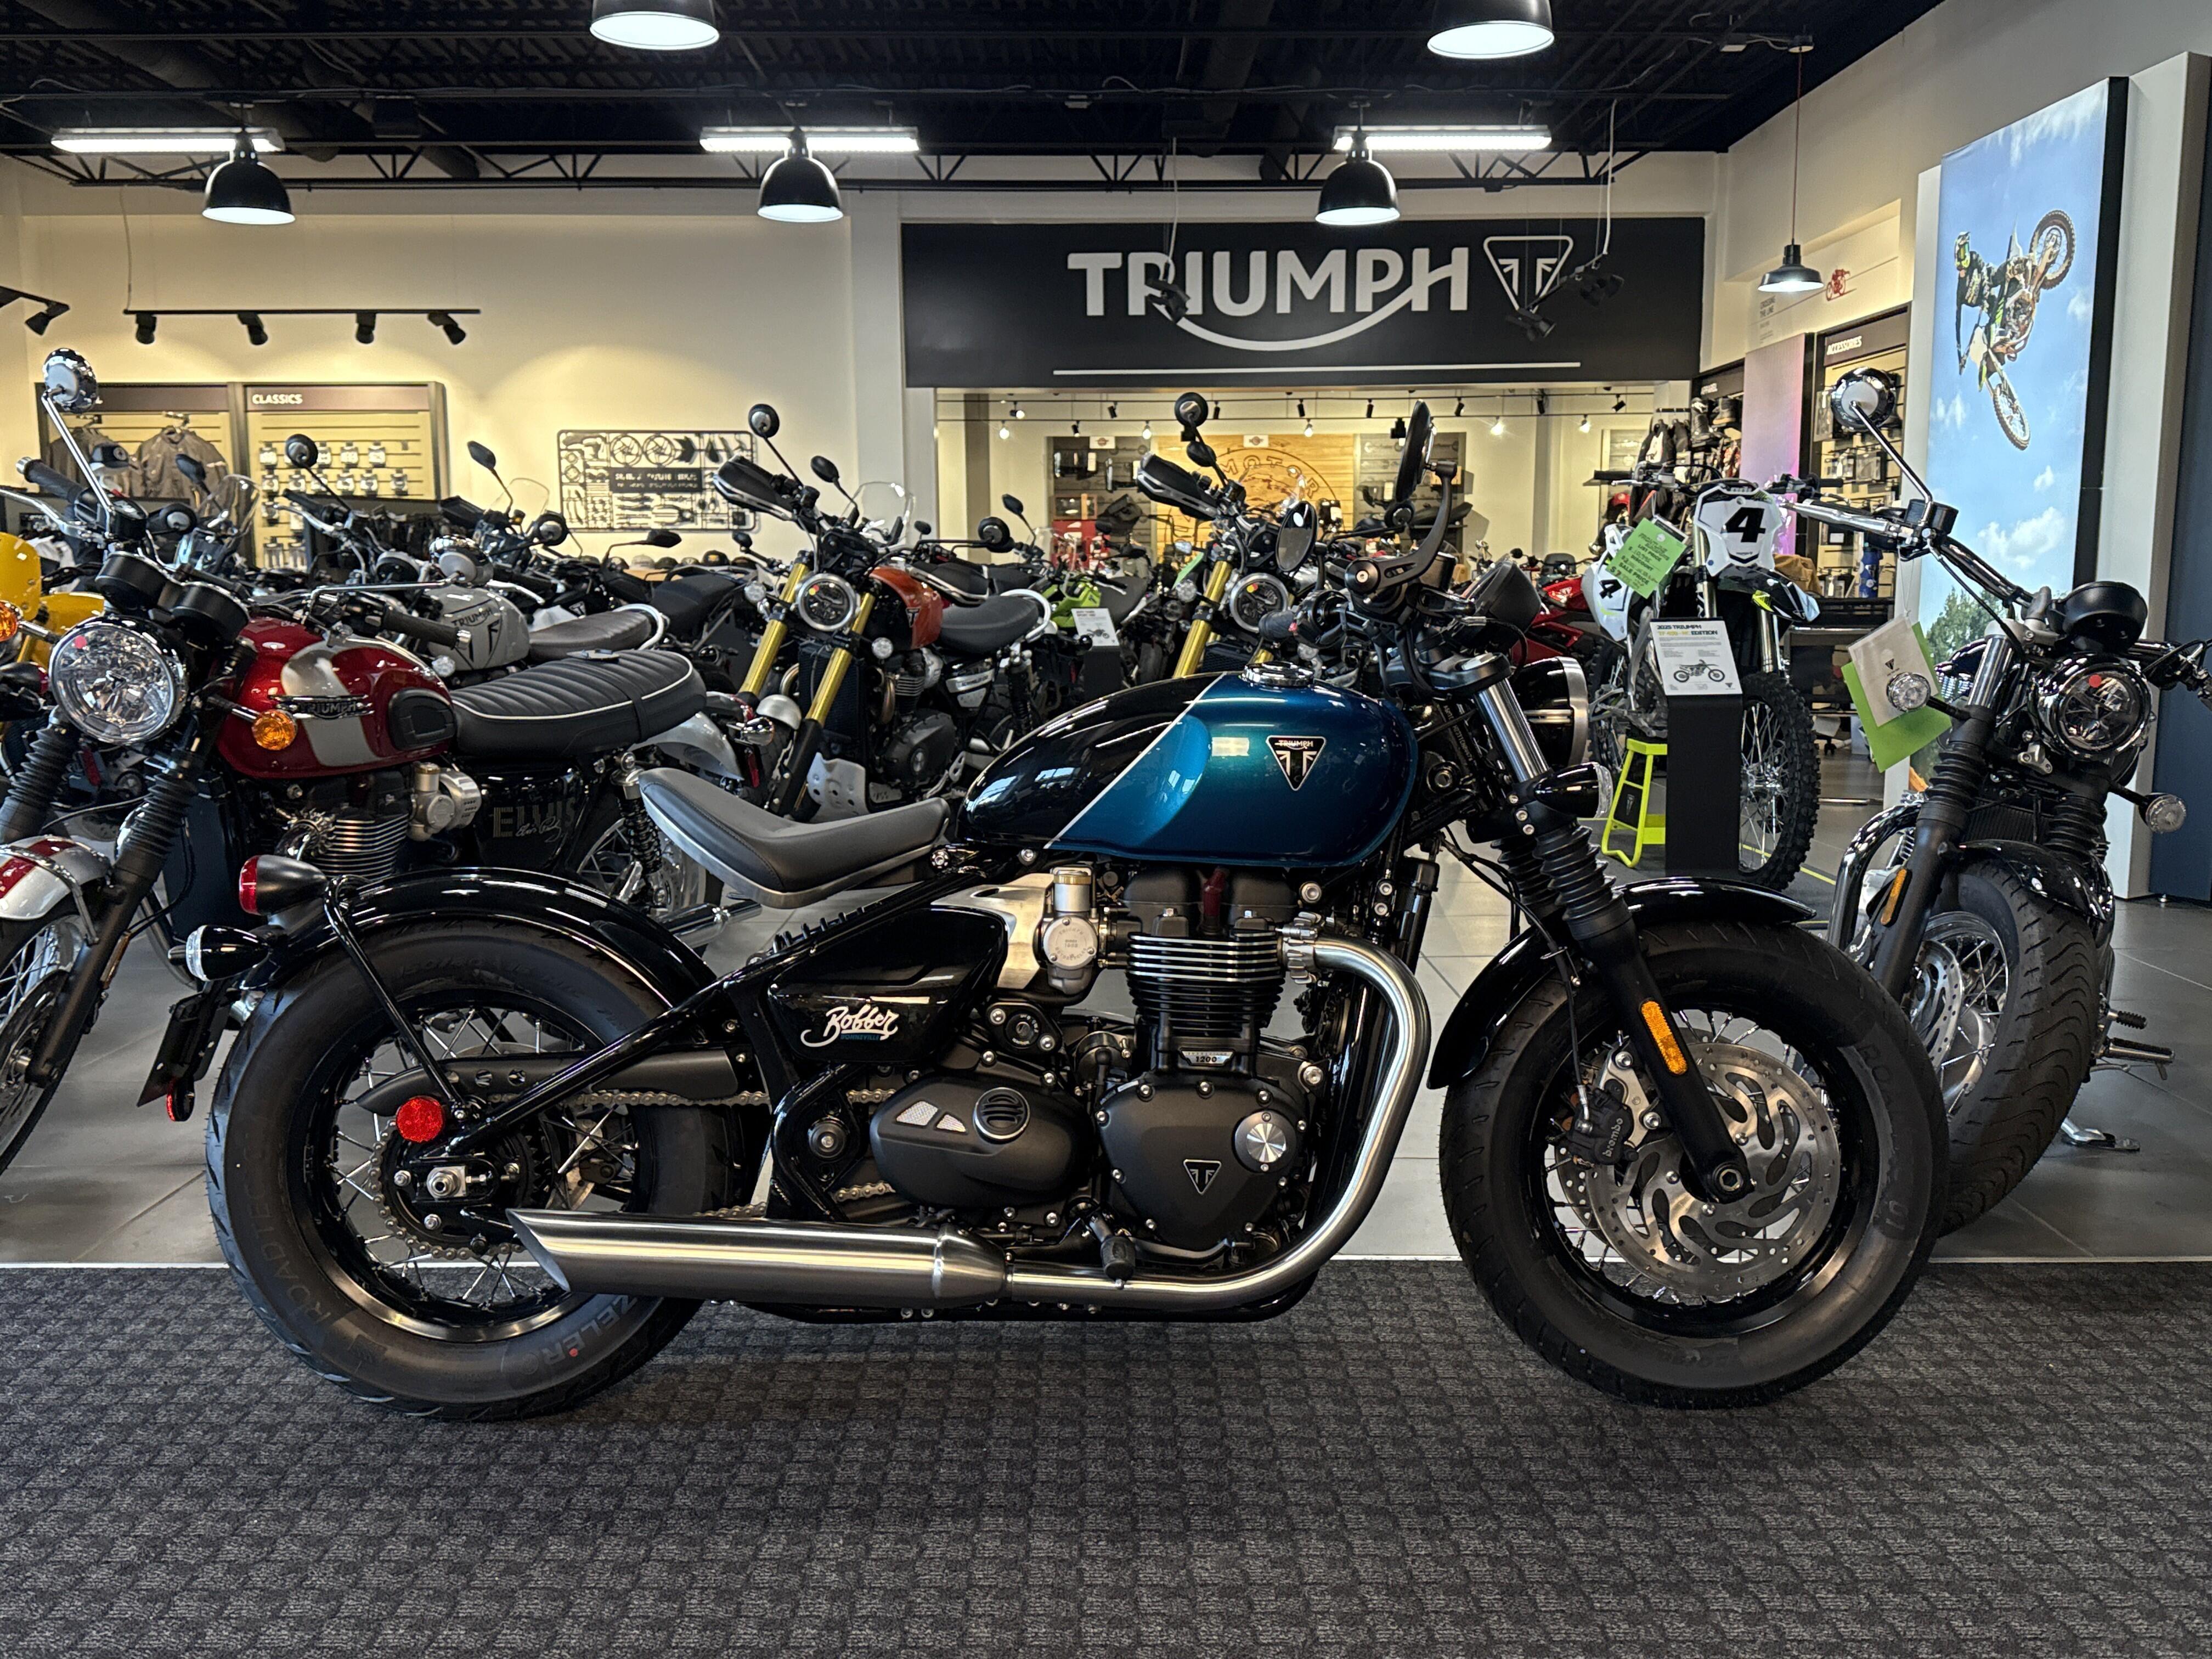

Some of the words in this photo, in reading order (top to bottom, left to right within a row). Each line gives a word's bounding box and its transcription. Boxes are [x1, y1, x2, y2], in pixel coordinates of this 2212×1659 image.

[1067, 247, 1469, 351] TRIUMPH
[1826, 336, 1862, 356] ACCESSORIES
[252, 394, 303, 404] CLASSICS
[1721, 507, 1766, 543] 4
[1618, 562, 1633, 574] SALE
[1632, 571, 1650, 585] PRICE
[1599, 579, 1622, 599] 4
[451, 607, 493, 627] TRIUMPH
[301, 701, 356, 718] TRIUMPH
[1278, 740, 1314, 750] TRIUMPH
[800, 1003, 899, 1047] Bobber
[1602, 1118, 1623, 1157] brembo
